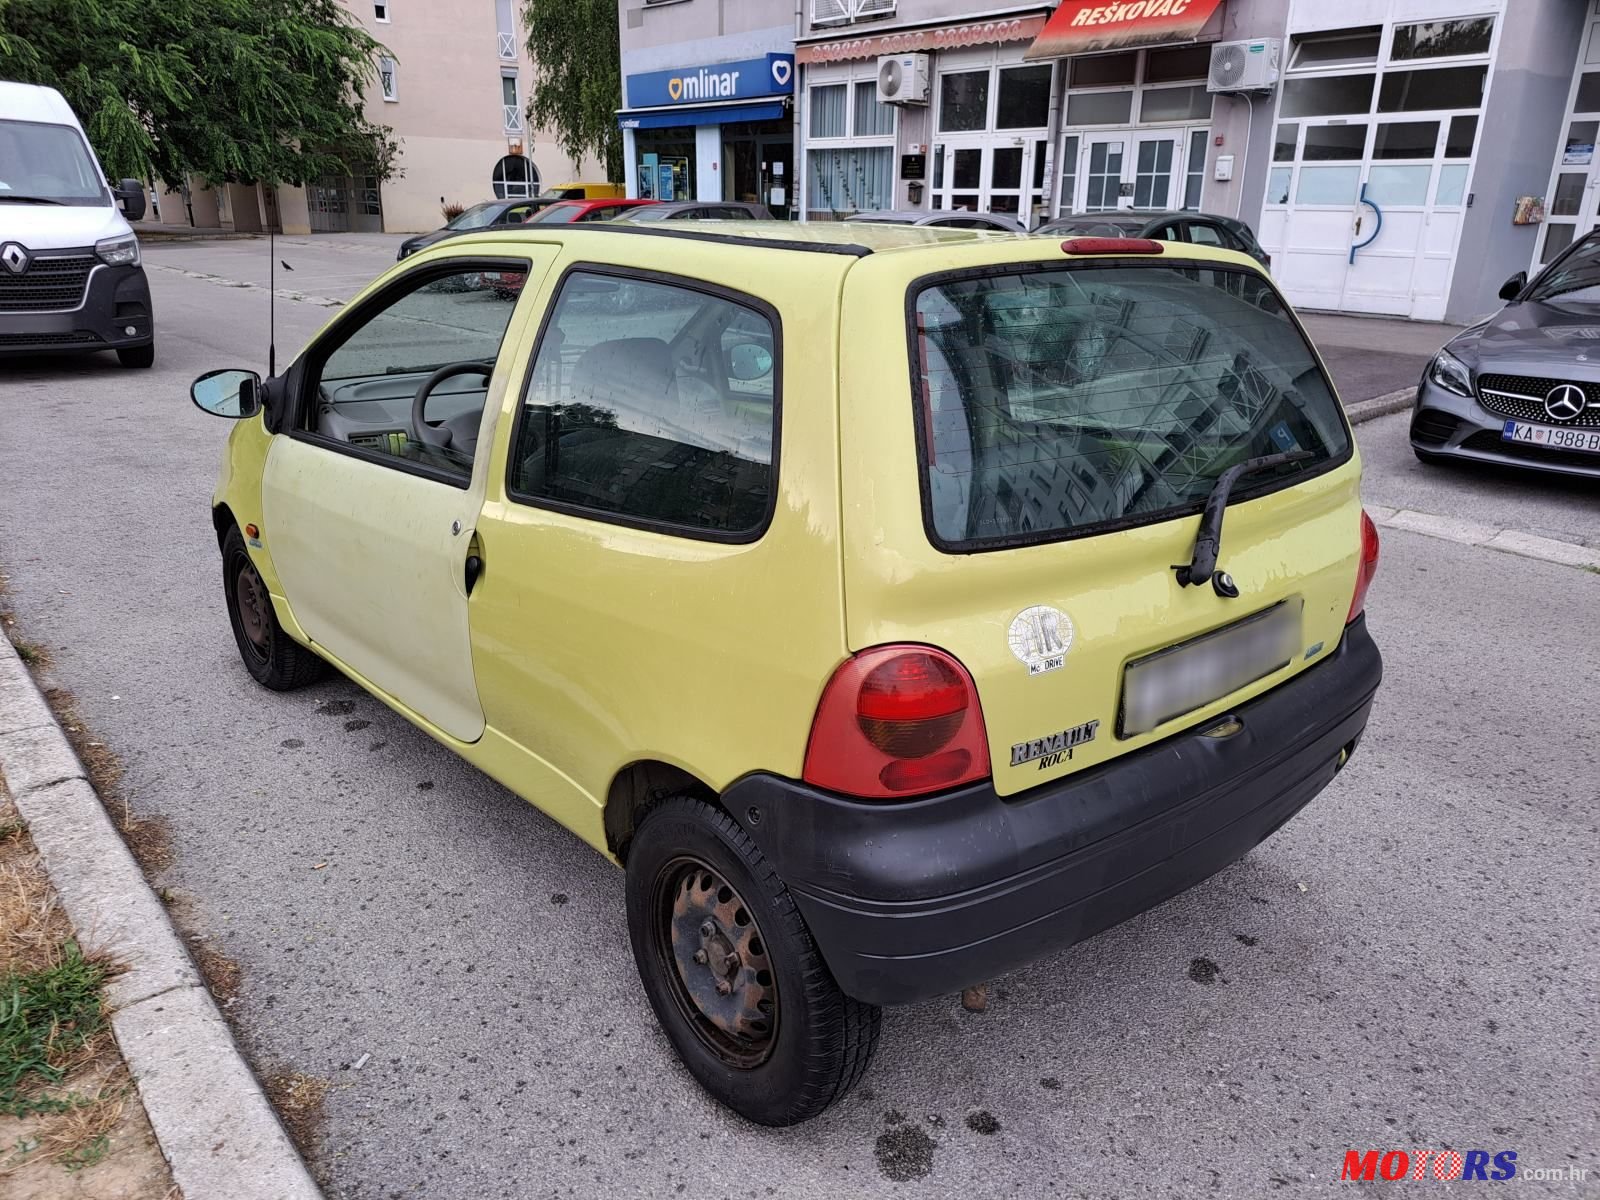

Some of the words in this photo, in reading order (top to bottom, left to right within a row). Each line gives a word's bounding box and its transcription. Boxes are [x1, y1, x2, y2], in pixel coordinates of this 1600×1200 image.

[1070, 0, 1192, 27] REŠKOVAC
[683, 68, 740, 100] mlinar
[1514, 424, 1532, 441] KA
[1045, 656, 1063, 670] DRIVE
[1010, 718, 1100, 767] RENAULT
[1038, 748, 1073, 771] ROCA
